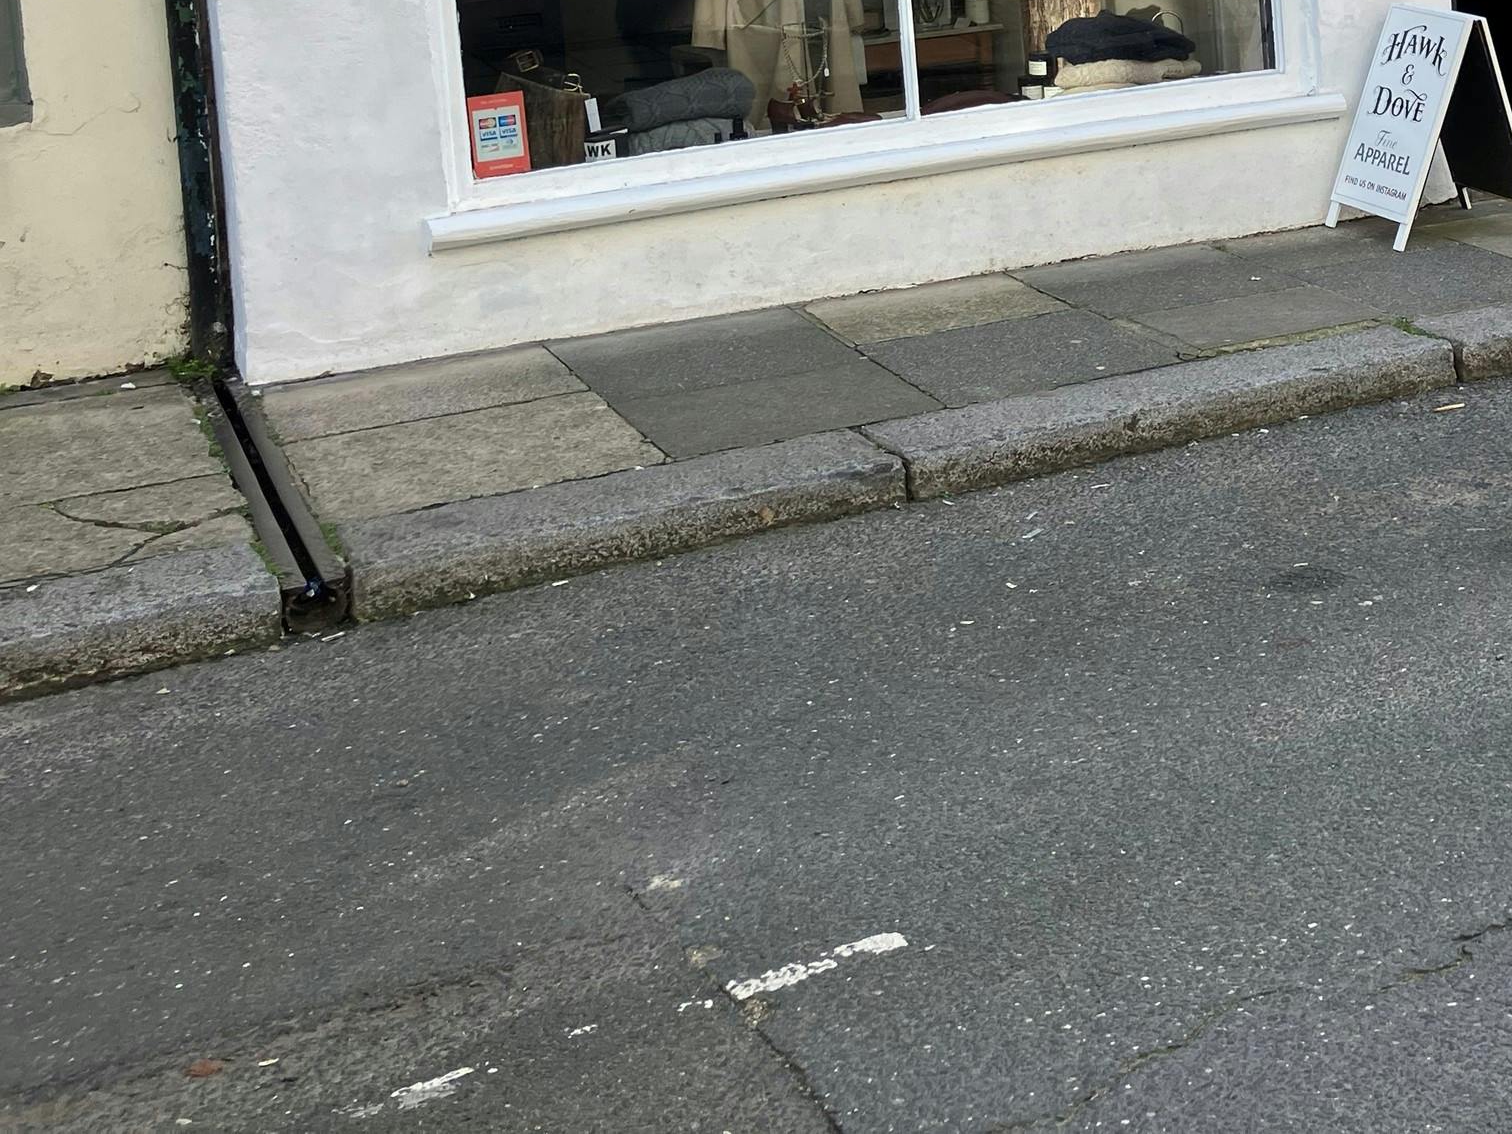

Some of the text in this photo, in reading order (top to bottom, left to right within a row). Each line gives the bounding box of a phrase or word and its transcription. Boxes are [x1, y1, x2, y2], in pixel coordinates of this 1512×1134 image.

[1401, 64, 1415, 85] &
[1367, 85, 1428, 123] DOVE
[482, 127, 517, 138] VISA VISA
[1375, 129, 1398, 149] Fine
[1354, 142, 1411, 176] APPAREL
[1345, 174, 1407, 201] FIND US ON INSTAGRAM
